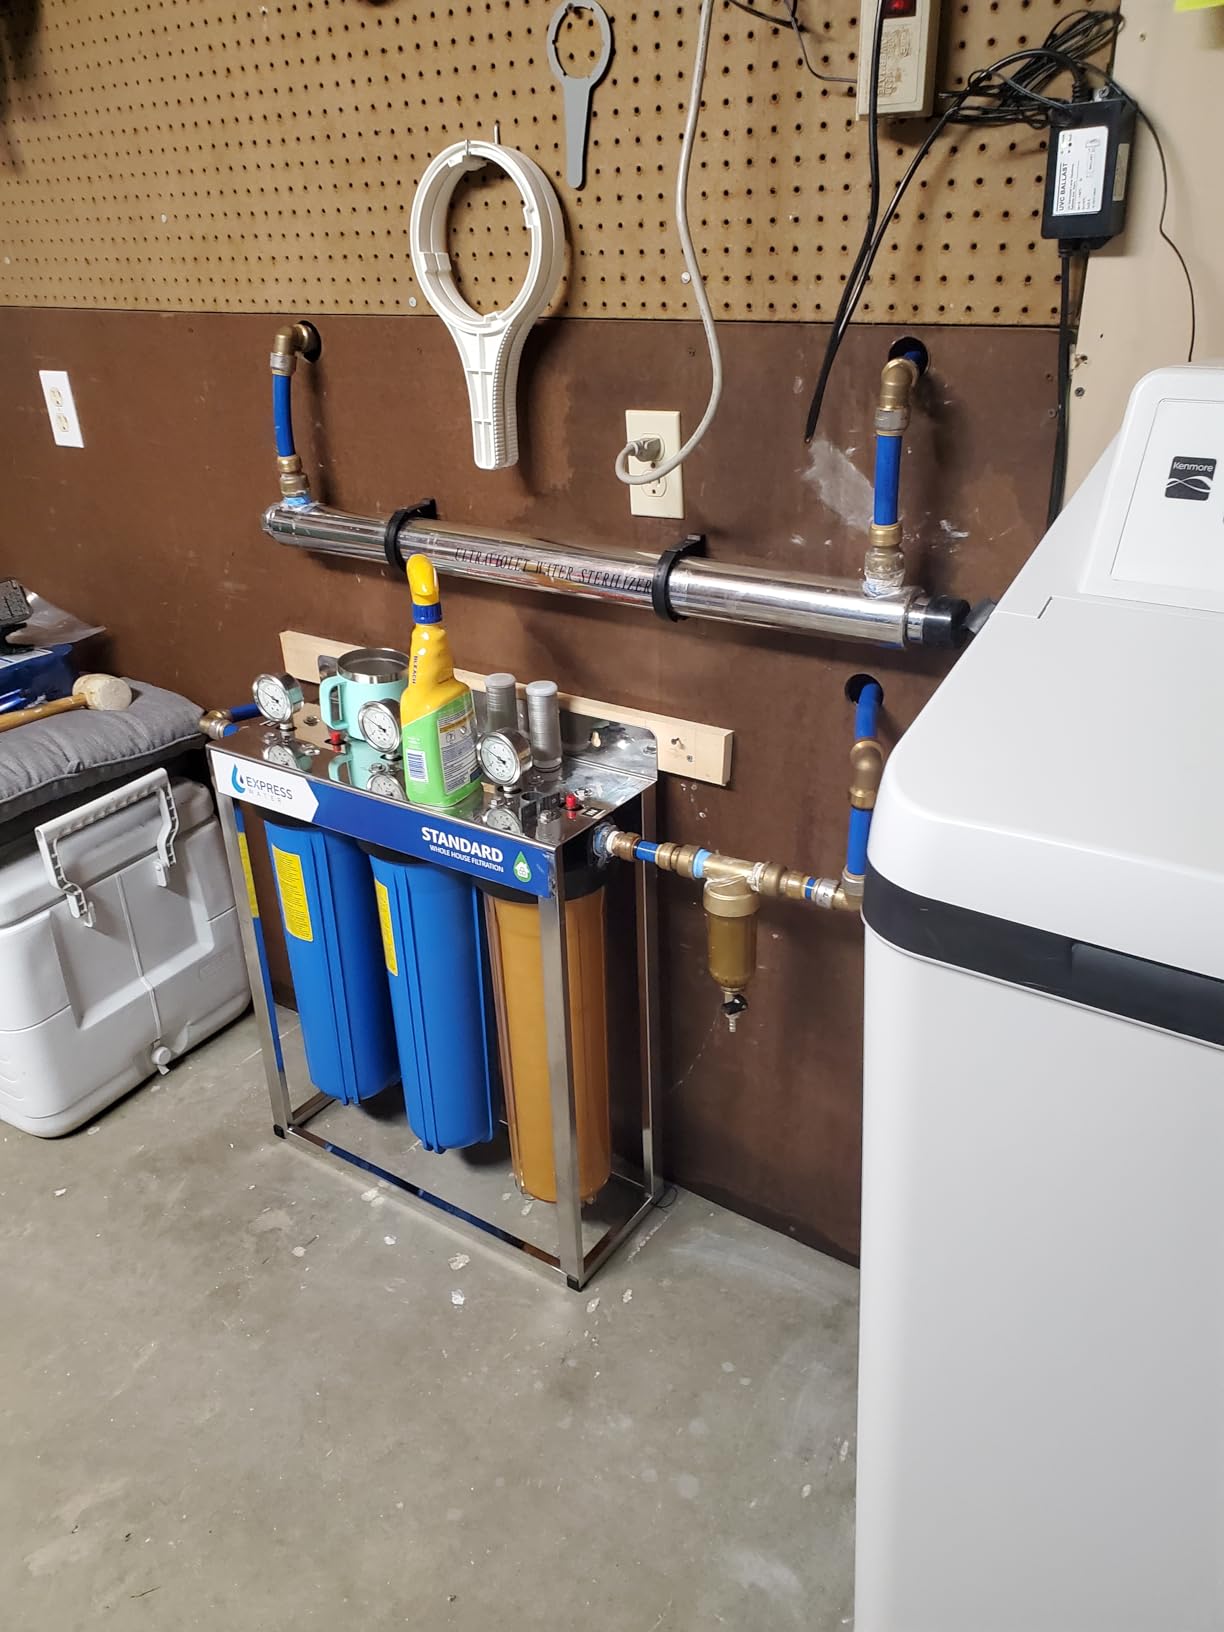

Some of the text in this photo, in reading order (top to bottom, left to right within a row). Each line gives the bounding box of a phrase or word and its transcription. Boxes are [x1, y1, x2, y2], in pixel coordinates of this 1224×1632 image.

[1058, 162, 1068, 211] UVC BALLAST
[1173, 462, 1213, 472] Kenmore
[454, 547, 529, 573] ULTRAVIOLET
[579, 568, 653, 594] STERILIZER
[246, 776, 293, 800] EXPRESS
[248, 789, 282, 803] WATER
[421, 827, 503, 862] STANDARD
[429, 845, 504, 873] WHOLE HOUSE FILTRATION
